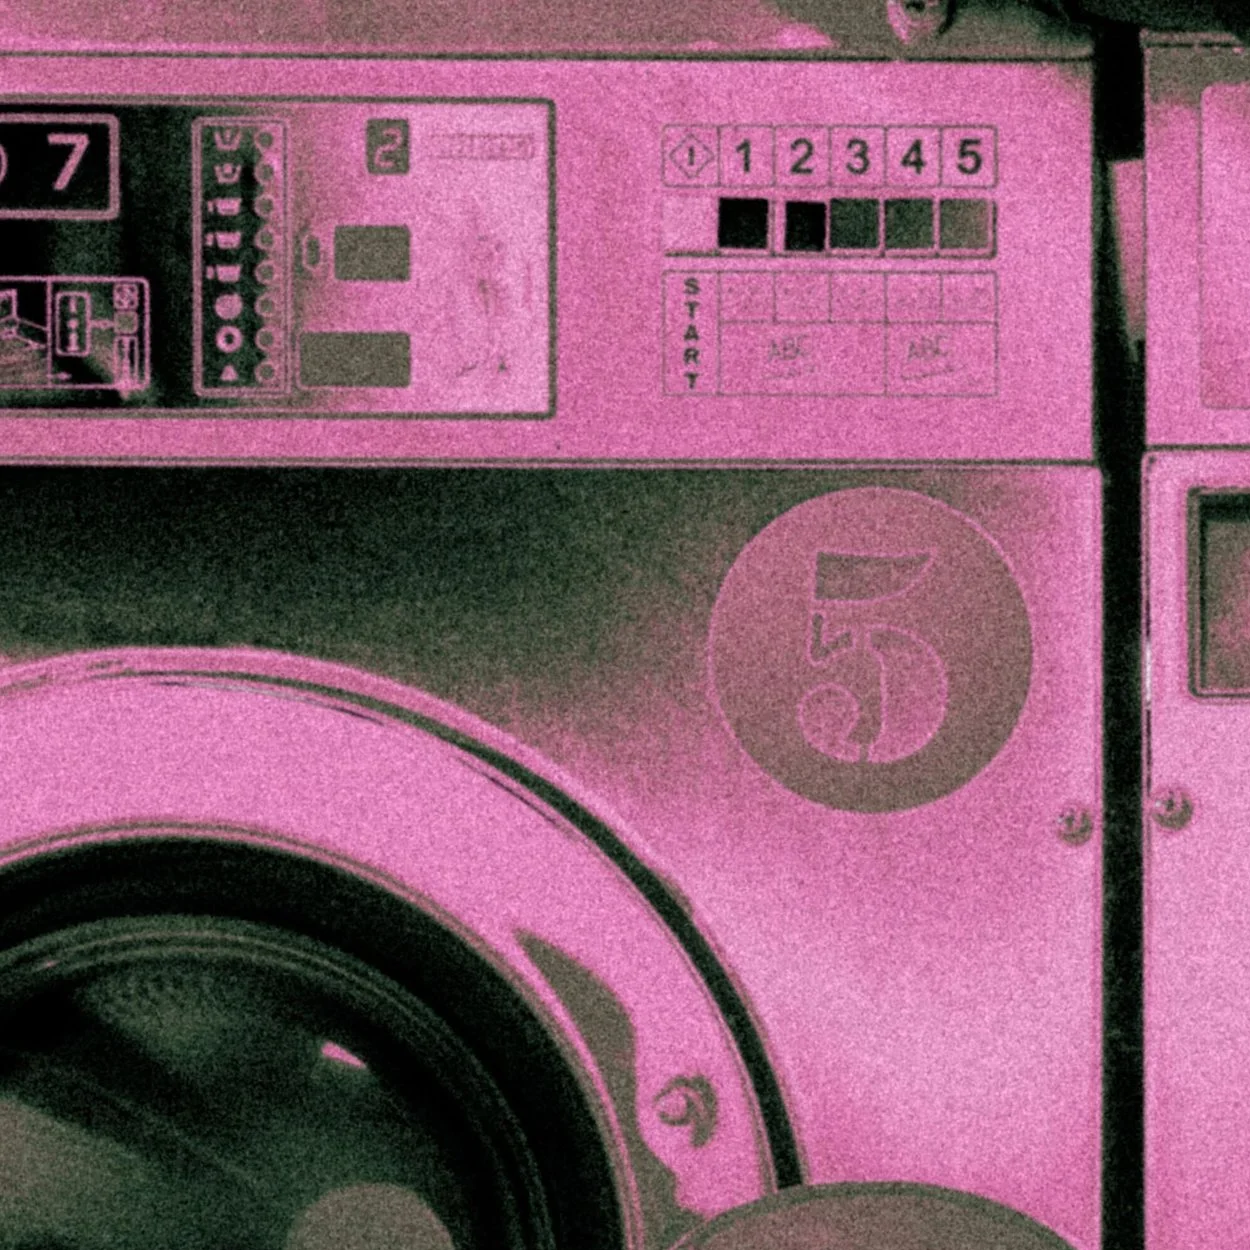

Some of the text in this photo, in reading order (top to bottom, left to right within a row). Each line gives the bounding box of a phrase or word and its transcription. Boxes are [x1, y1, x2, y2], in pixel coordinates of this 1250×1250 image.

[47, 133, 89, 190] 7
[374, 128, 402, 168] 2
[735, 138, 983, 175] 1 2 3 4 5
[683, 277, 700, 389] START
[797, 548, 948, 764] 5
